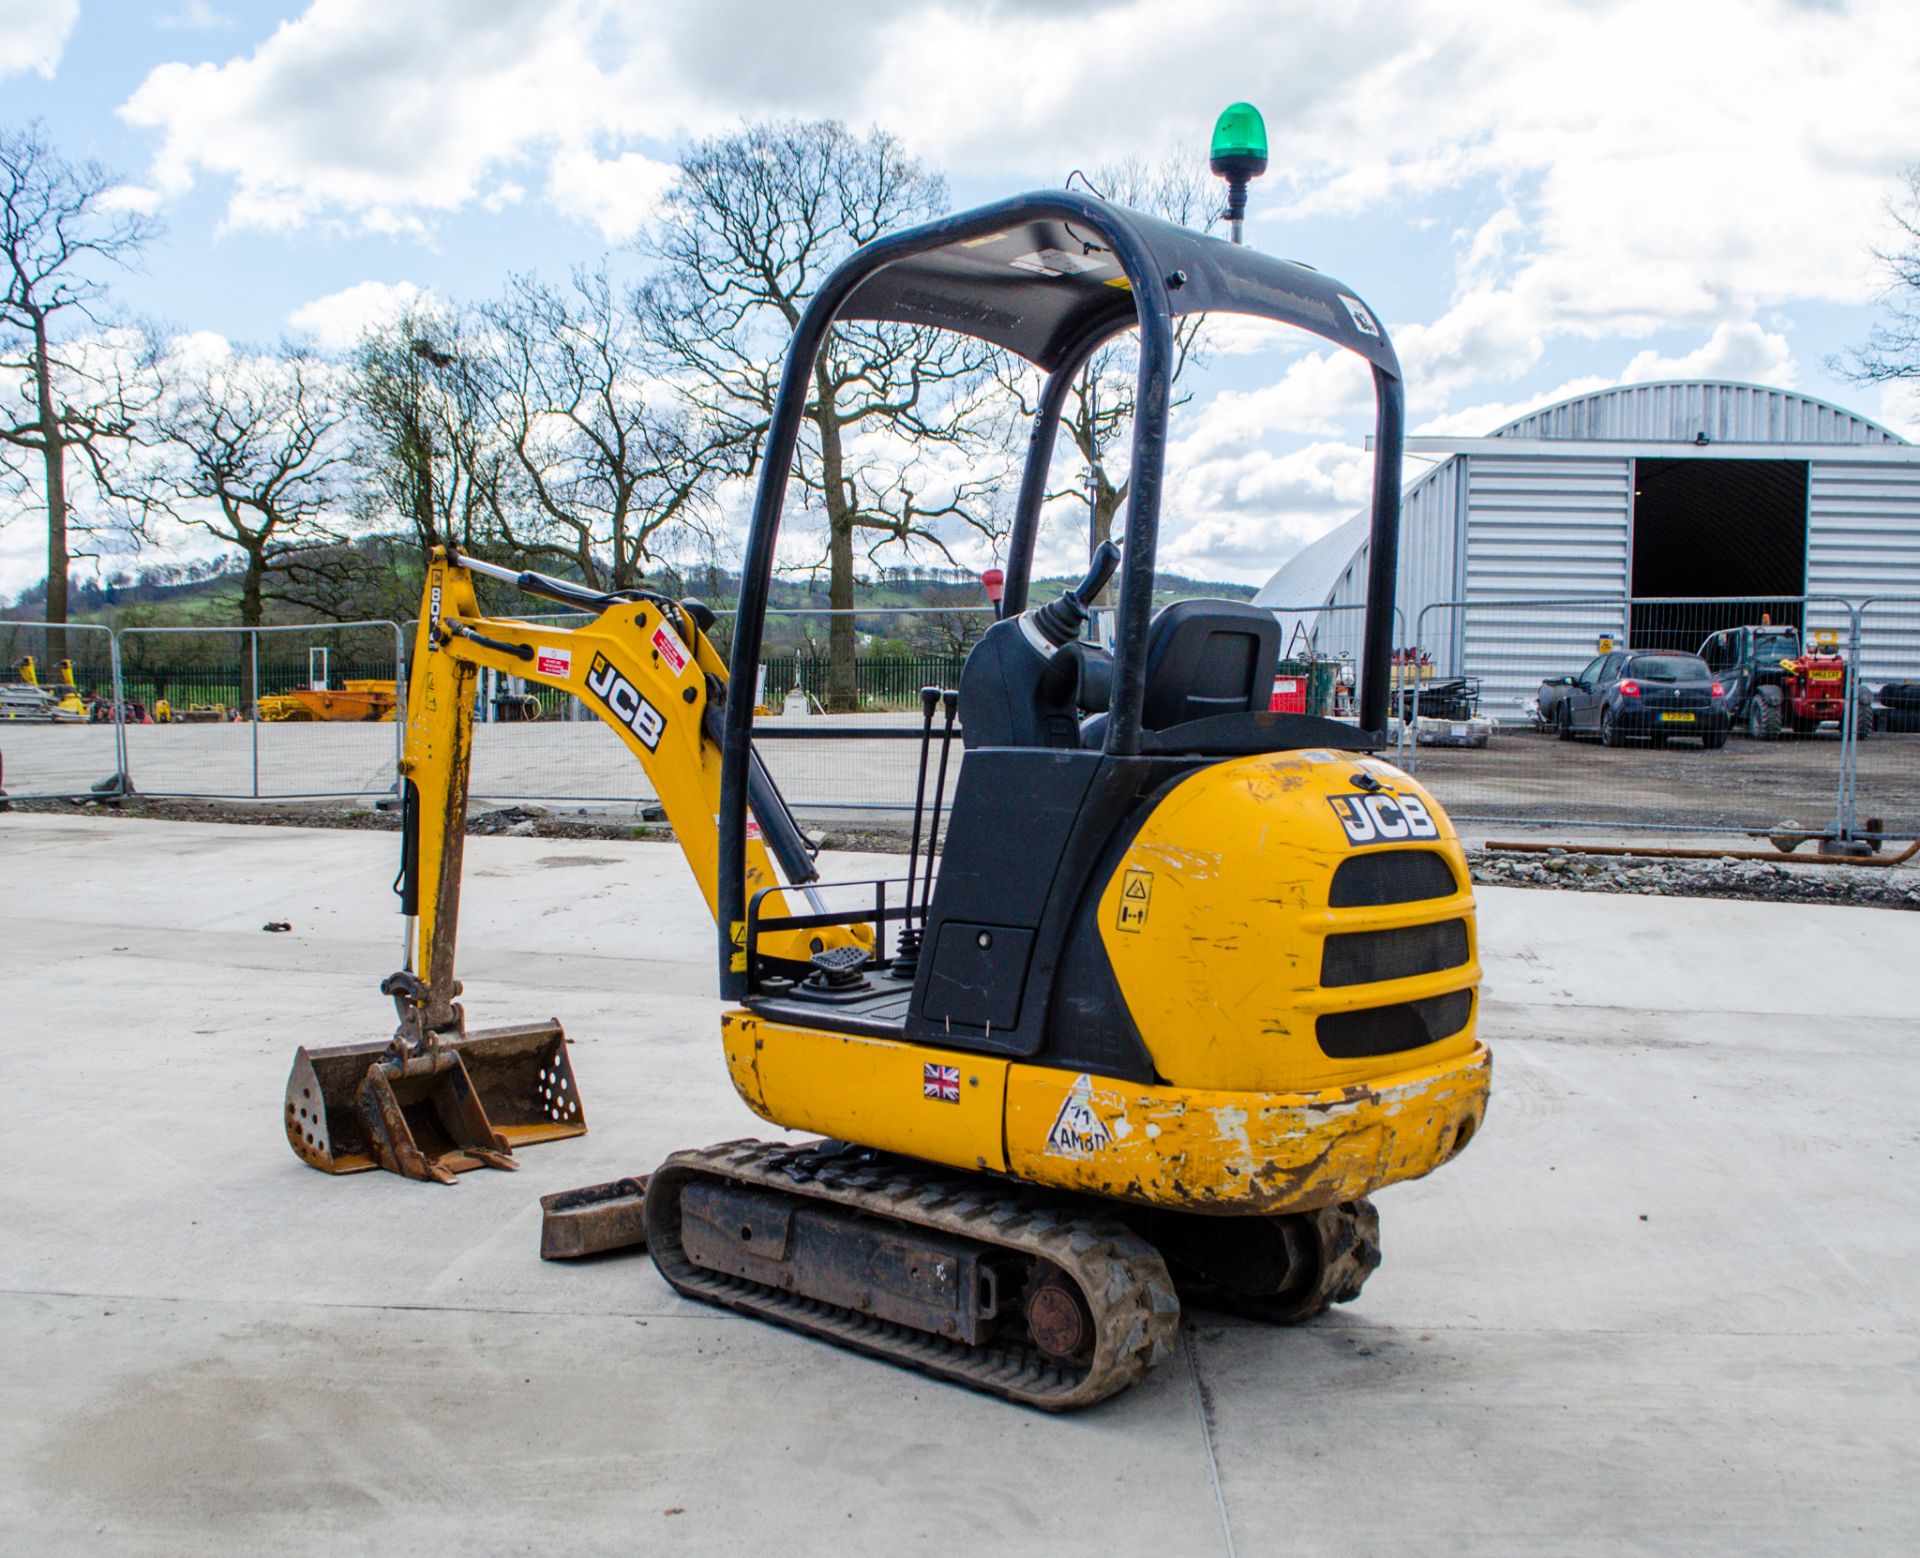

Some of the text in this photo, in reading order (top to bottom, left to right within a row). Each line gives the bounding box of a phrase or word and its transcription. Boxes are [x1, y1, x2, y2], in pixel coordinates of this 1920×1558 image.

[588, 665, 664, 749] JCB
[1343, 794, 1437, 841] JCB
[1071, 1105, 1090, 1126] 71
